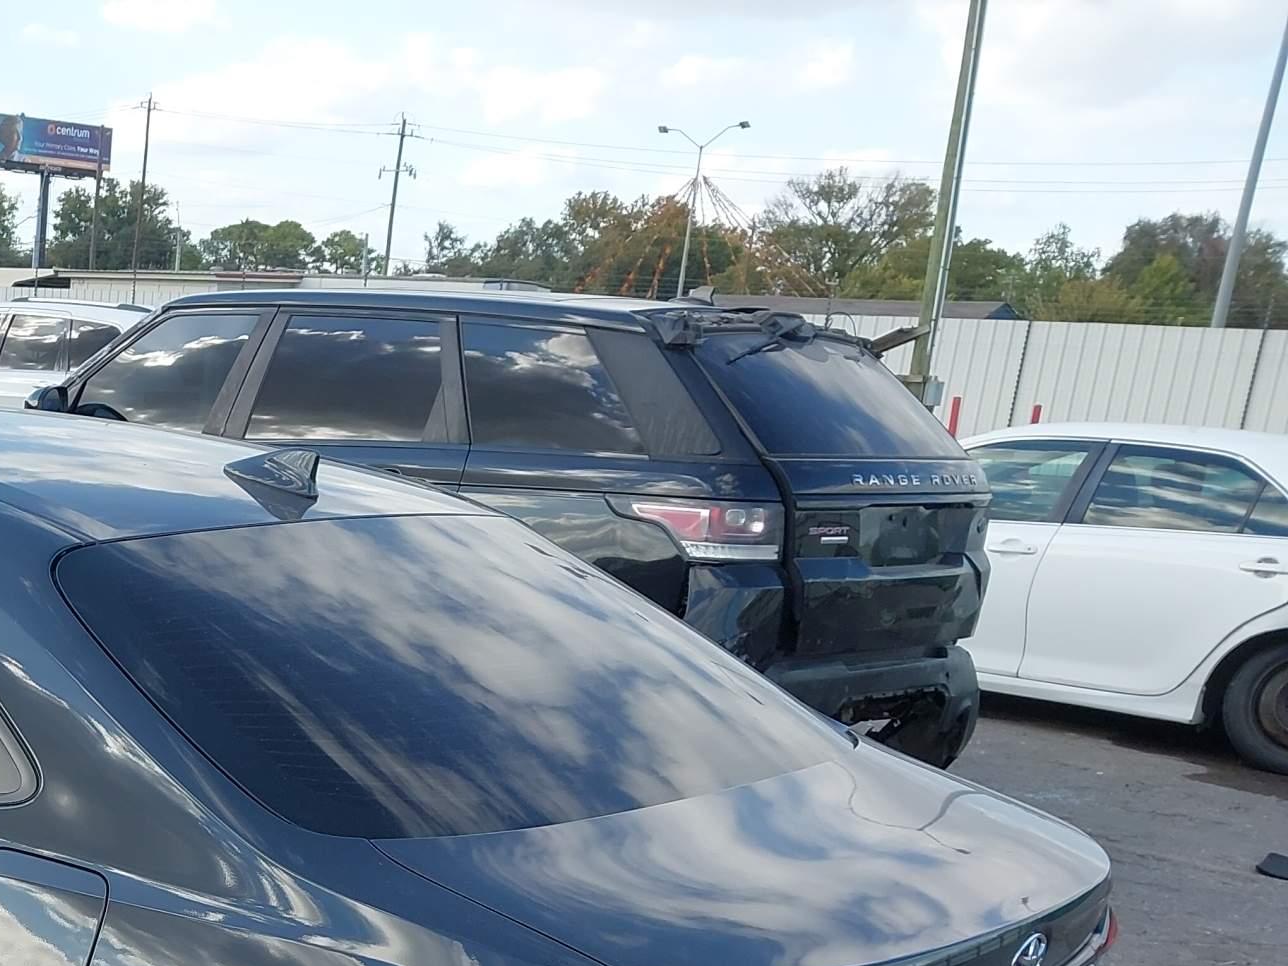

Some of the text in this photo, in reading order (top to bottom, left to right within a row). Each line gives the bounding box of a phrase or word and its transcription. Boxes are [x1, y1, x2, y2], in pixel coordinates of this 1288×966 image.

[851, 474, 977, 486] RANGE ROVER
[808, 526, 850, 536] SPORT
